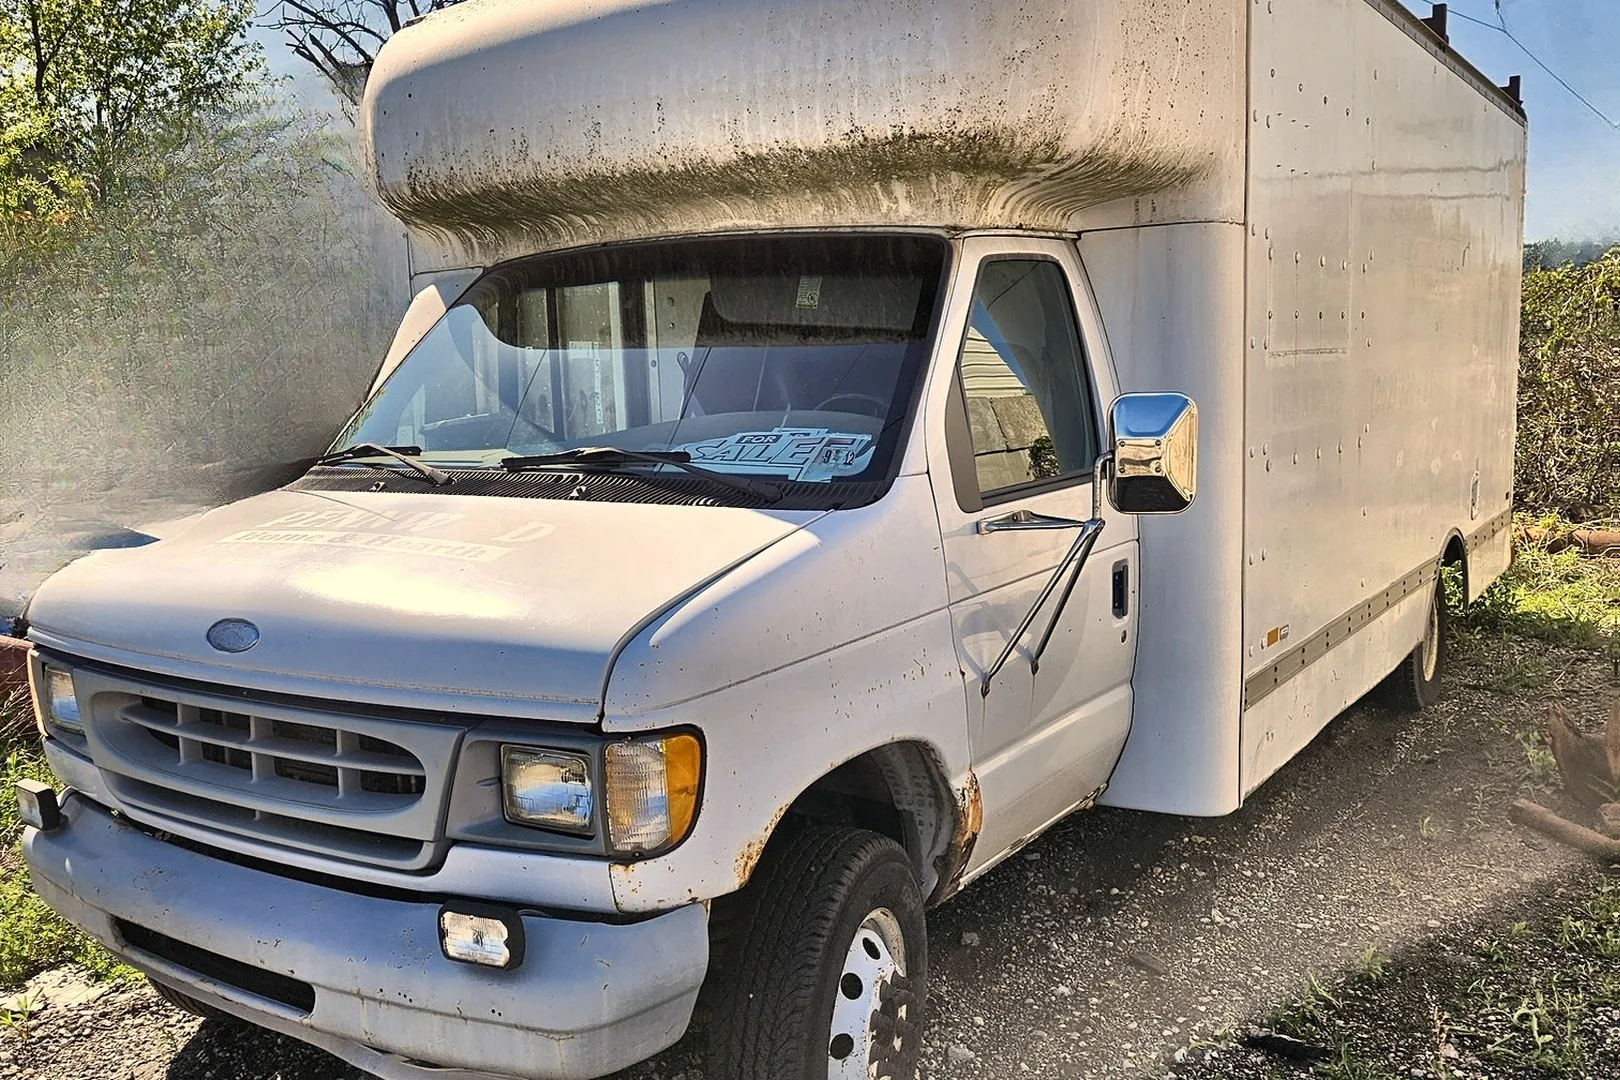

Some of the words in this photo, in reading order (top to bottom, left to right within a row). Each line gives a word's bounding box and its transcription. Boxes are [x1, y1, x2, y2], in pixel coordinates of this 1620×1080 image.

[741, 435, 777, 443] FOR
[824, 449, 832, 464] 9
[843, 451, 855, 465] 12
[235, 530, 324, 542] Home
[363, 535, 488, 558] Hearth
